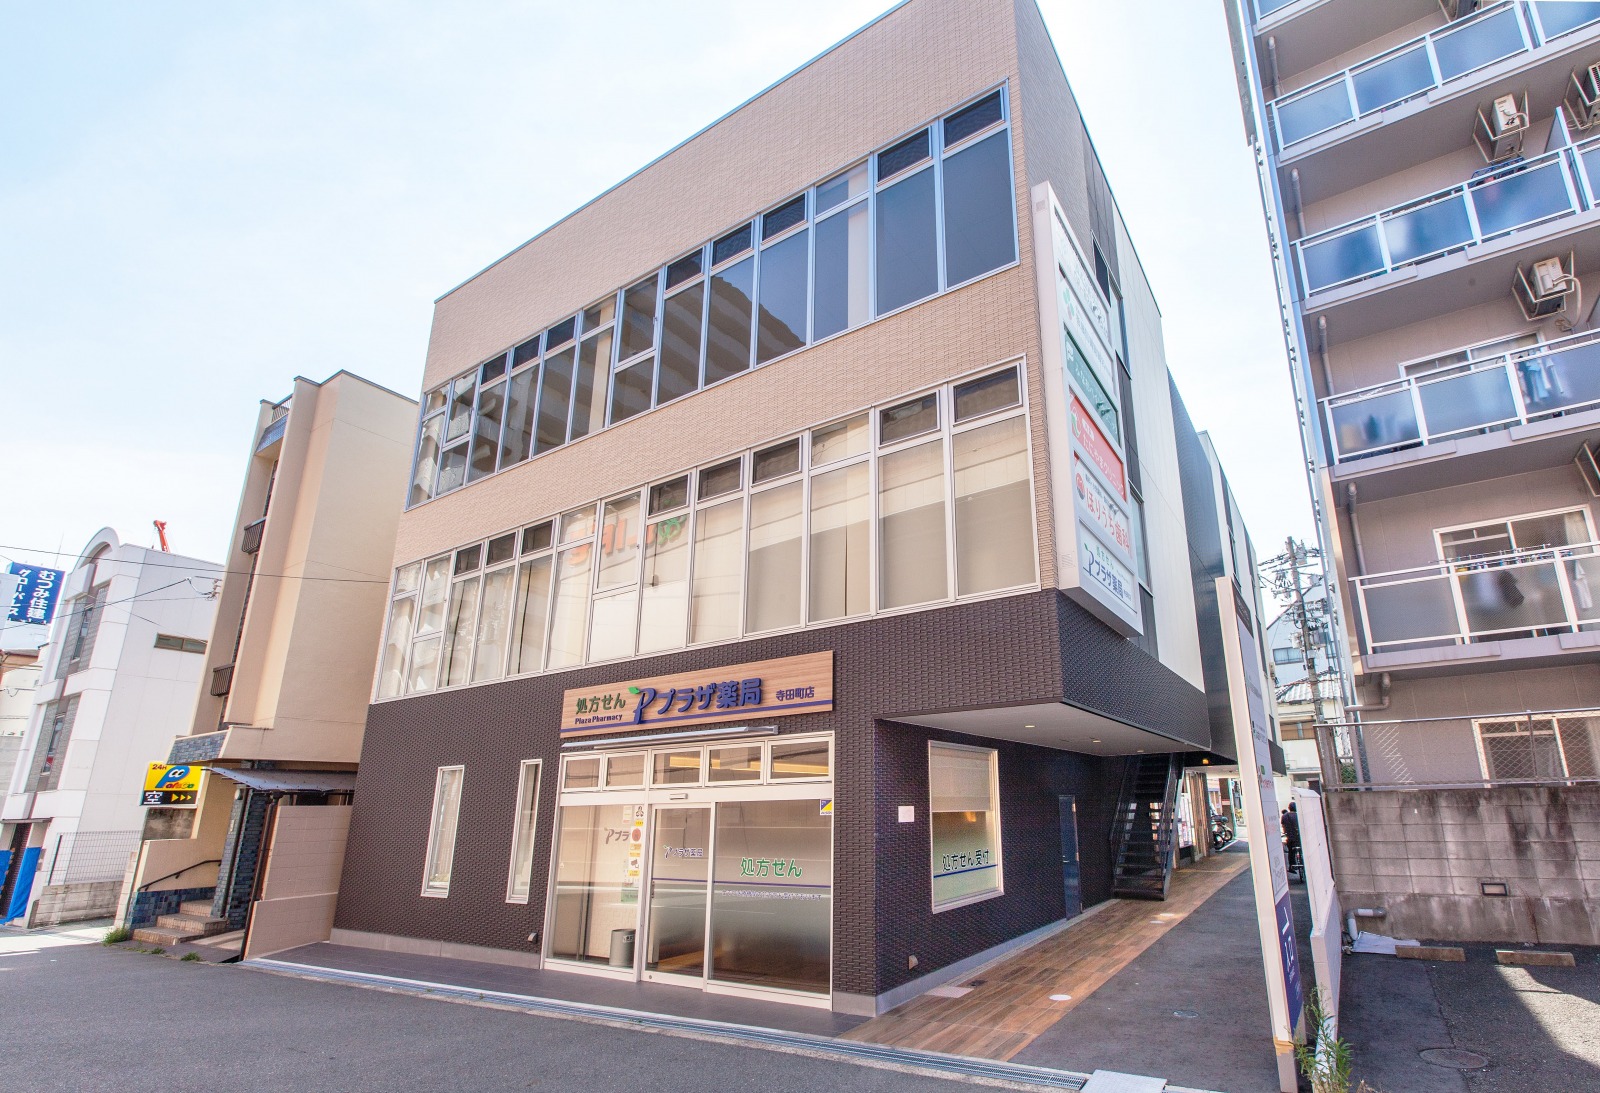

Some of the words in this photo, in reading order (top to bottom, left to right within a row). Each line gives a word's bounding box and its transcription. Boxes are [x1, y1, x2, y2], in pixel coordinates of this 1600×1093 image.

[26, 570, 57, 619] むつみ住建
[575, 692, 627, 715] 処方せん
[657, 677, 763, 715] プラザ薬局
[775, 686, 815, 702] 寺田町店
[575, 717, 592, 725] Plaza
[592, 714, 623, 723] Pharmacy
[143, 790, 164, 805] 空
[740, 857, 803, 878] 処方せん
[942, 849, 990, 872] 処方せん受付
